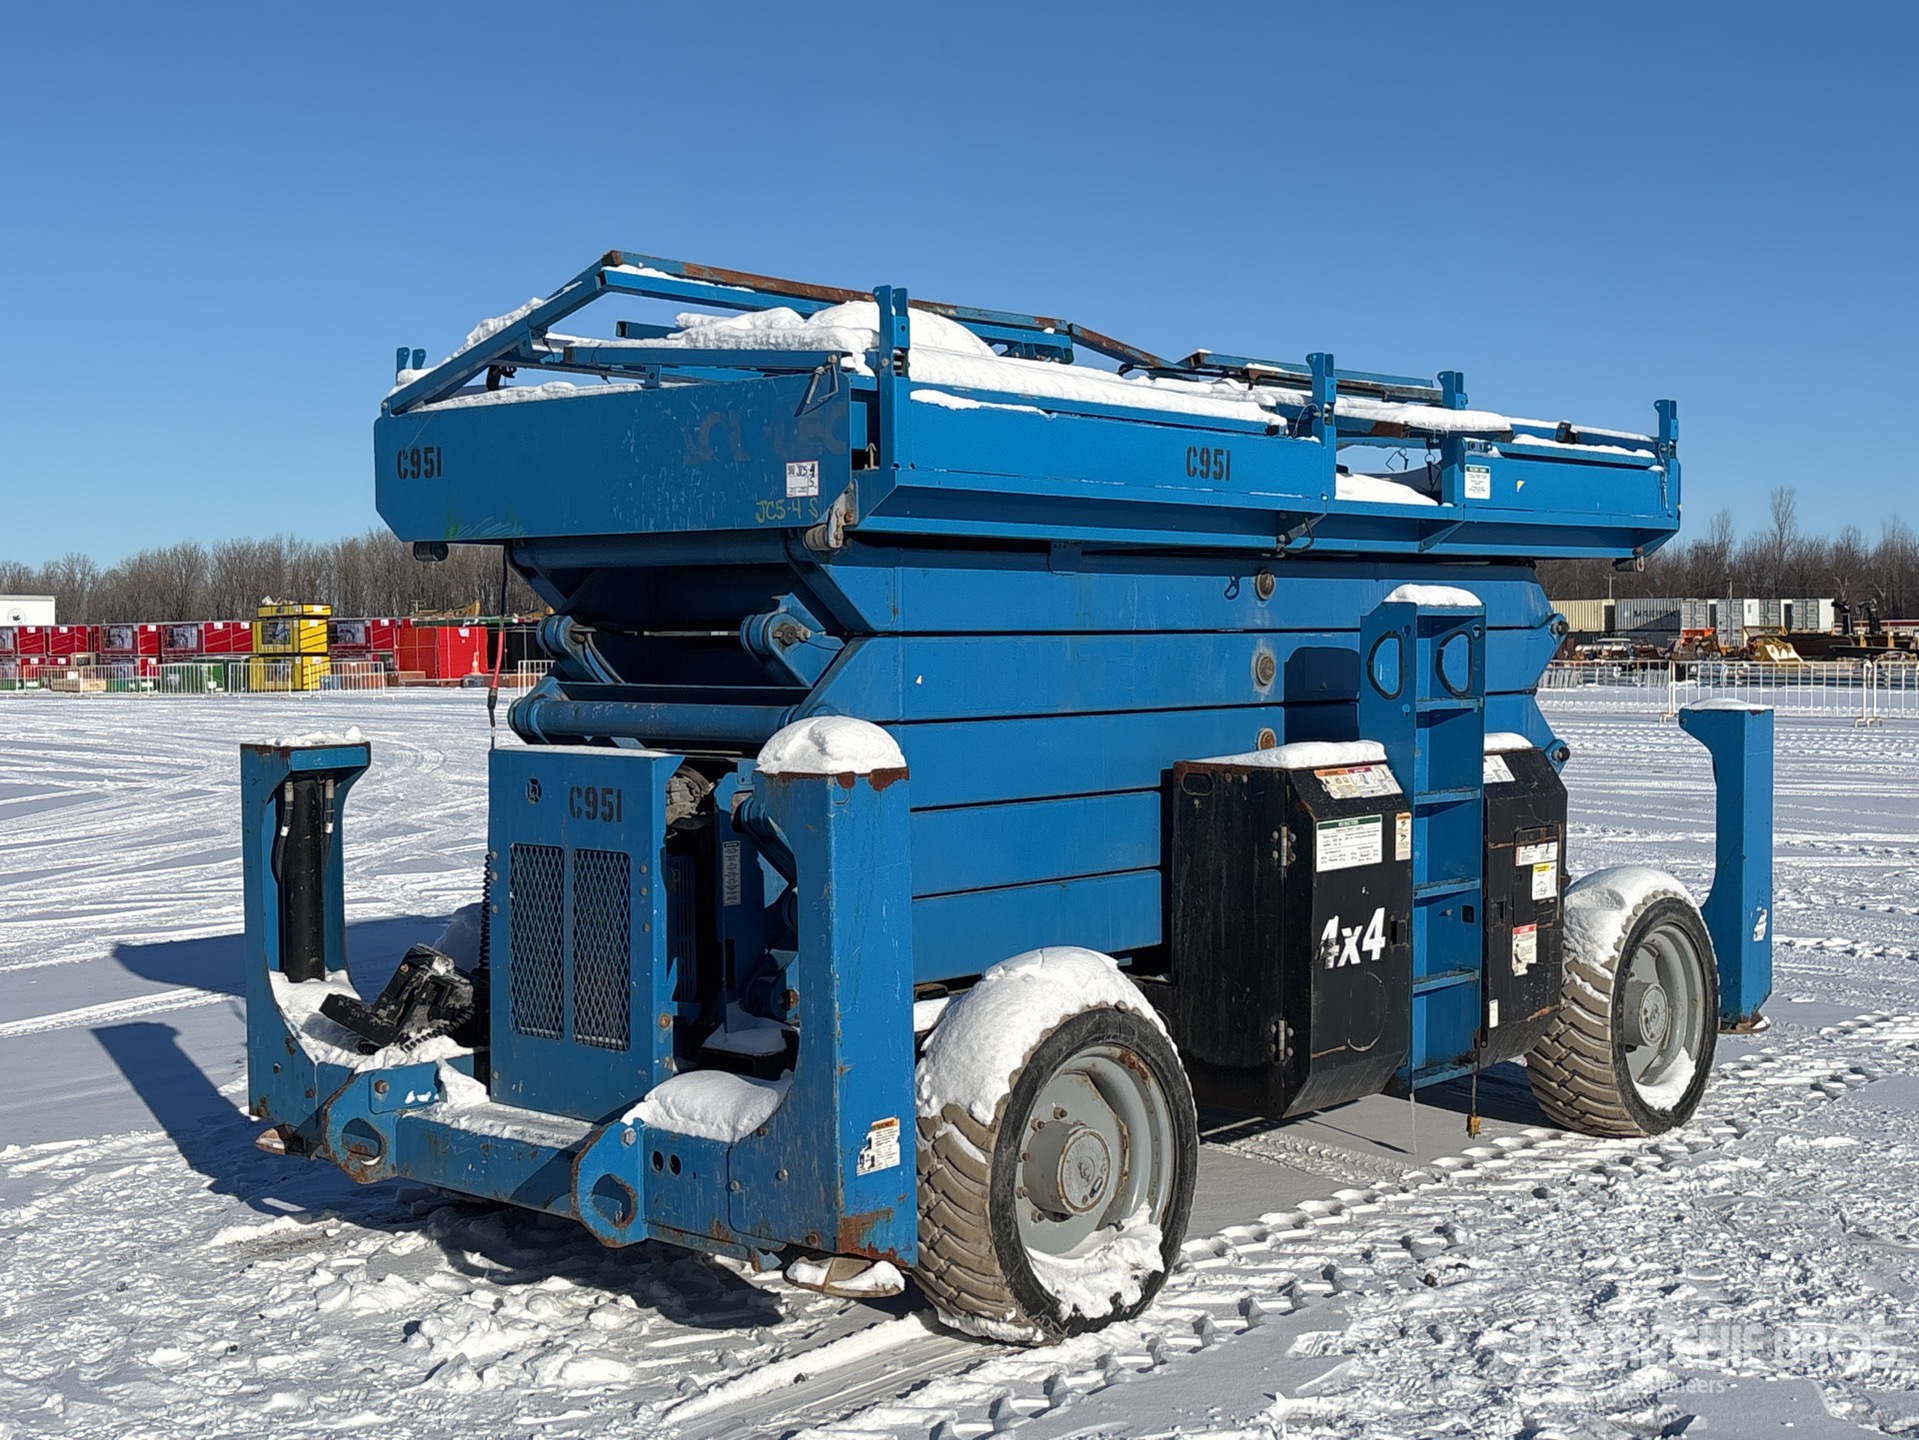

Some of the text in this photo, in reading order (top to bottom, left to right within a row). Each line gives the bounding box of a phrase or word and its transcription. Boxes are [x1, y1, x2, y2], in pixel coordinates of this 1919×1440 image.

[397, 446, 442, 480] C951
[1186, 446, 1231, 481] C951
[569, 786, 622, 823] C951
[1317, 907, 1386, 970] 4x4
